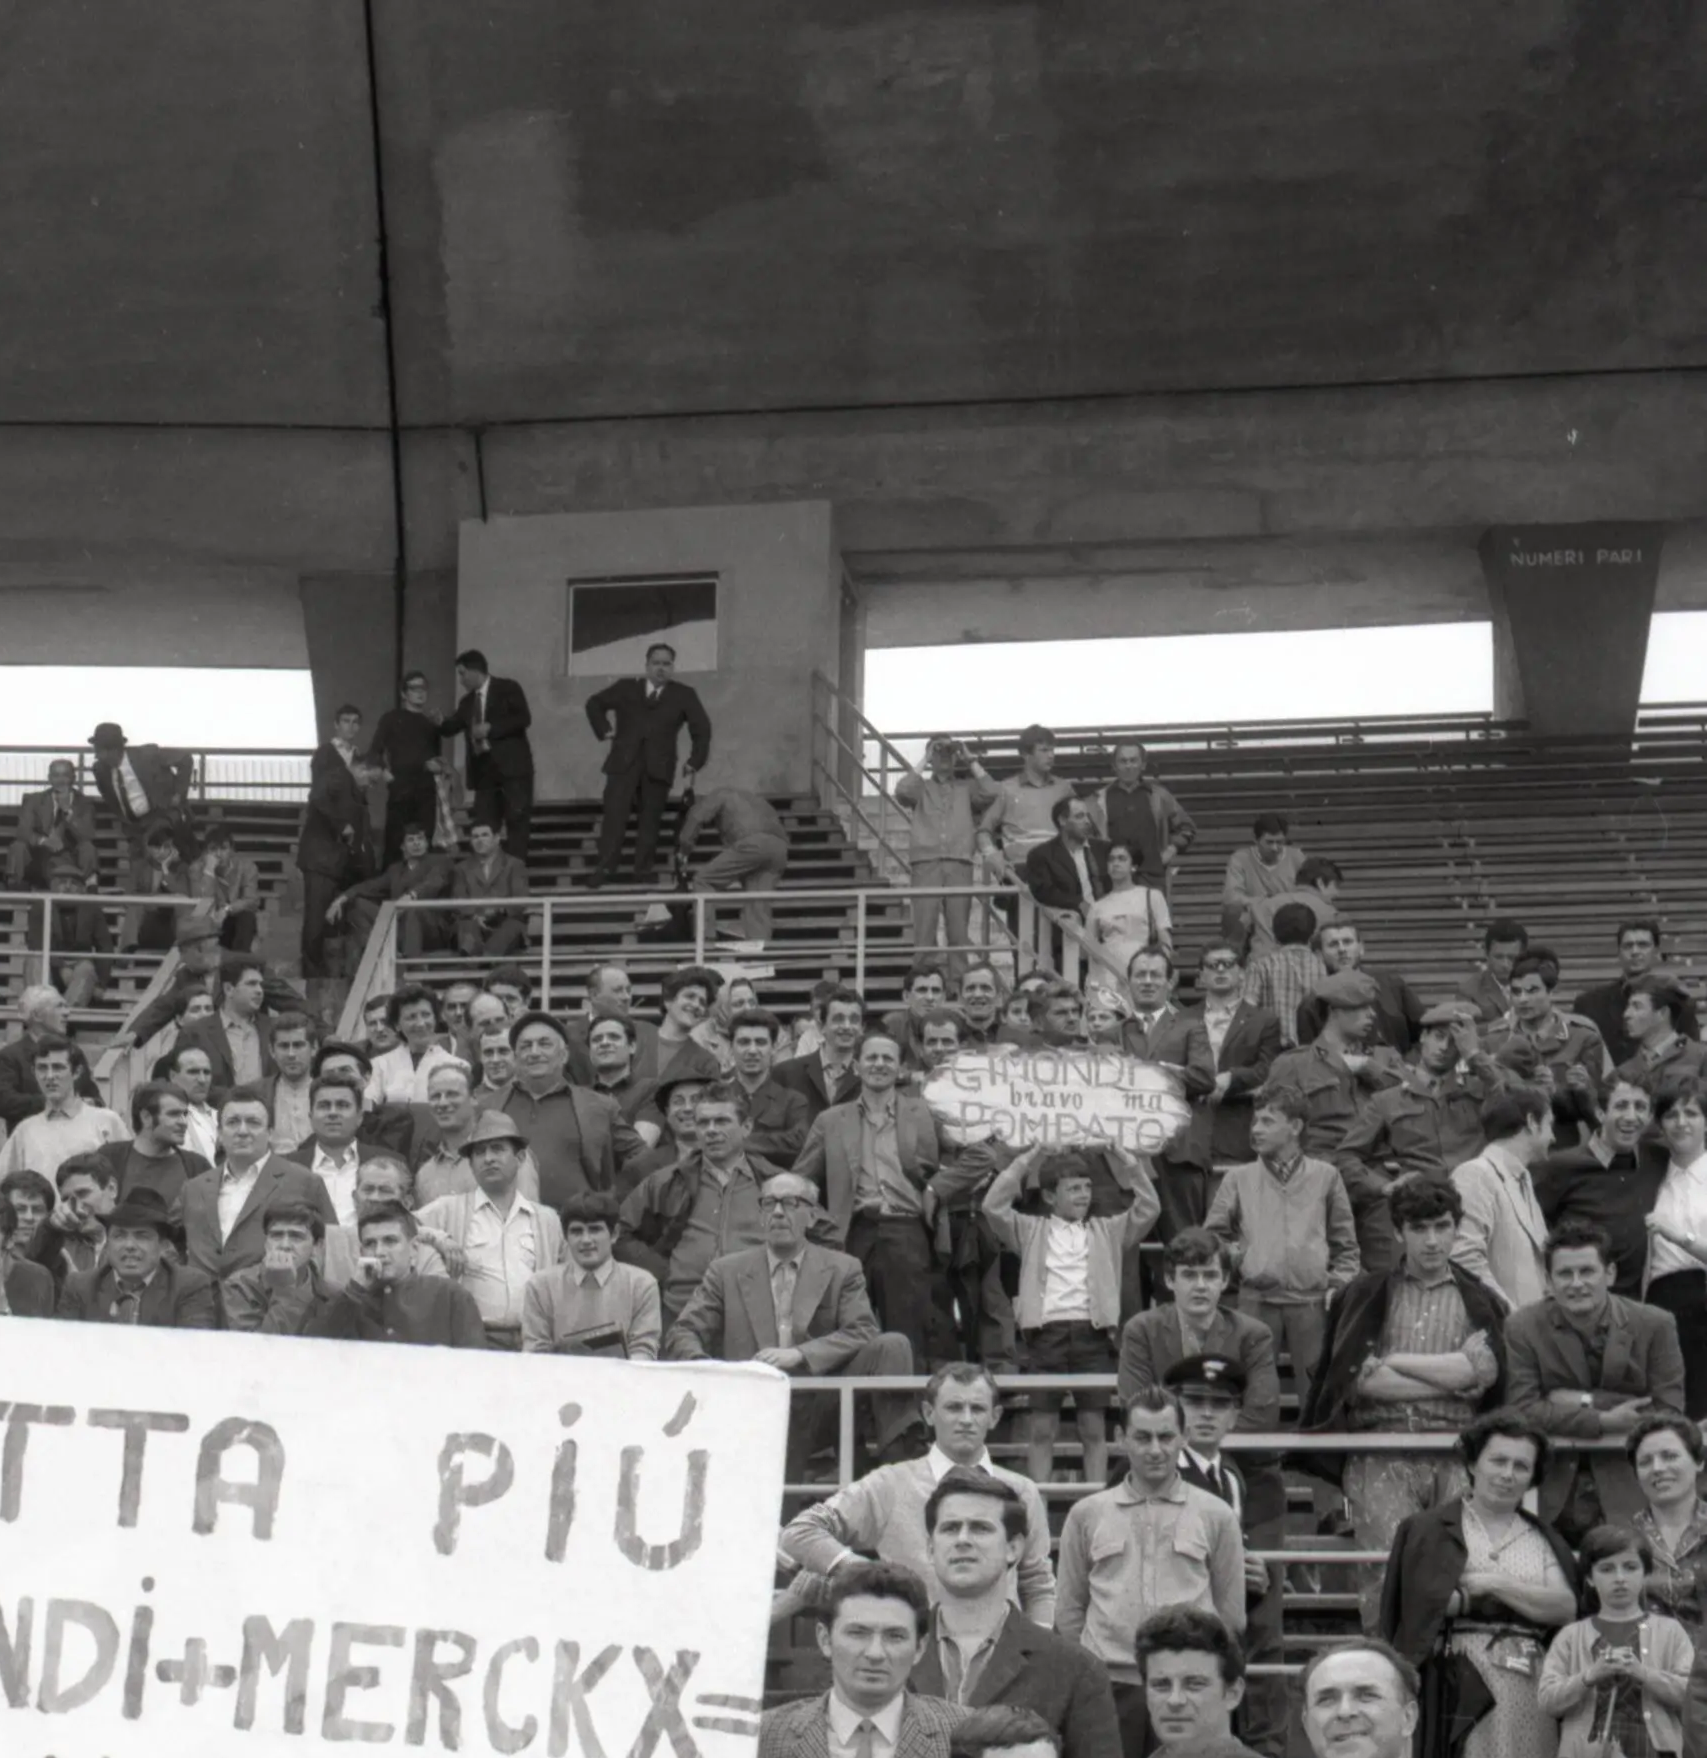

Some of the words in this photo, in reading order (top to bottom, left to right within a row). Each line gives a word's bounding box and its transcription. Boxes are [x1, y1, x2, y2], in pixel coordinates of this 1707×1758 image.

[1509, 549, 1585, 567] NUMERI
[1596, 548, 1643, 565] PARI
[950, 1050, 1137, 1091] GIMONDI
[1009, 1082, 1084, 1110] bravo
[1122, 1091, 1164, 1112] ma
